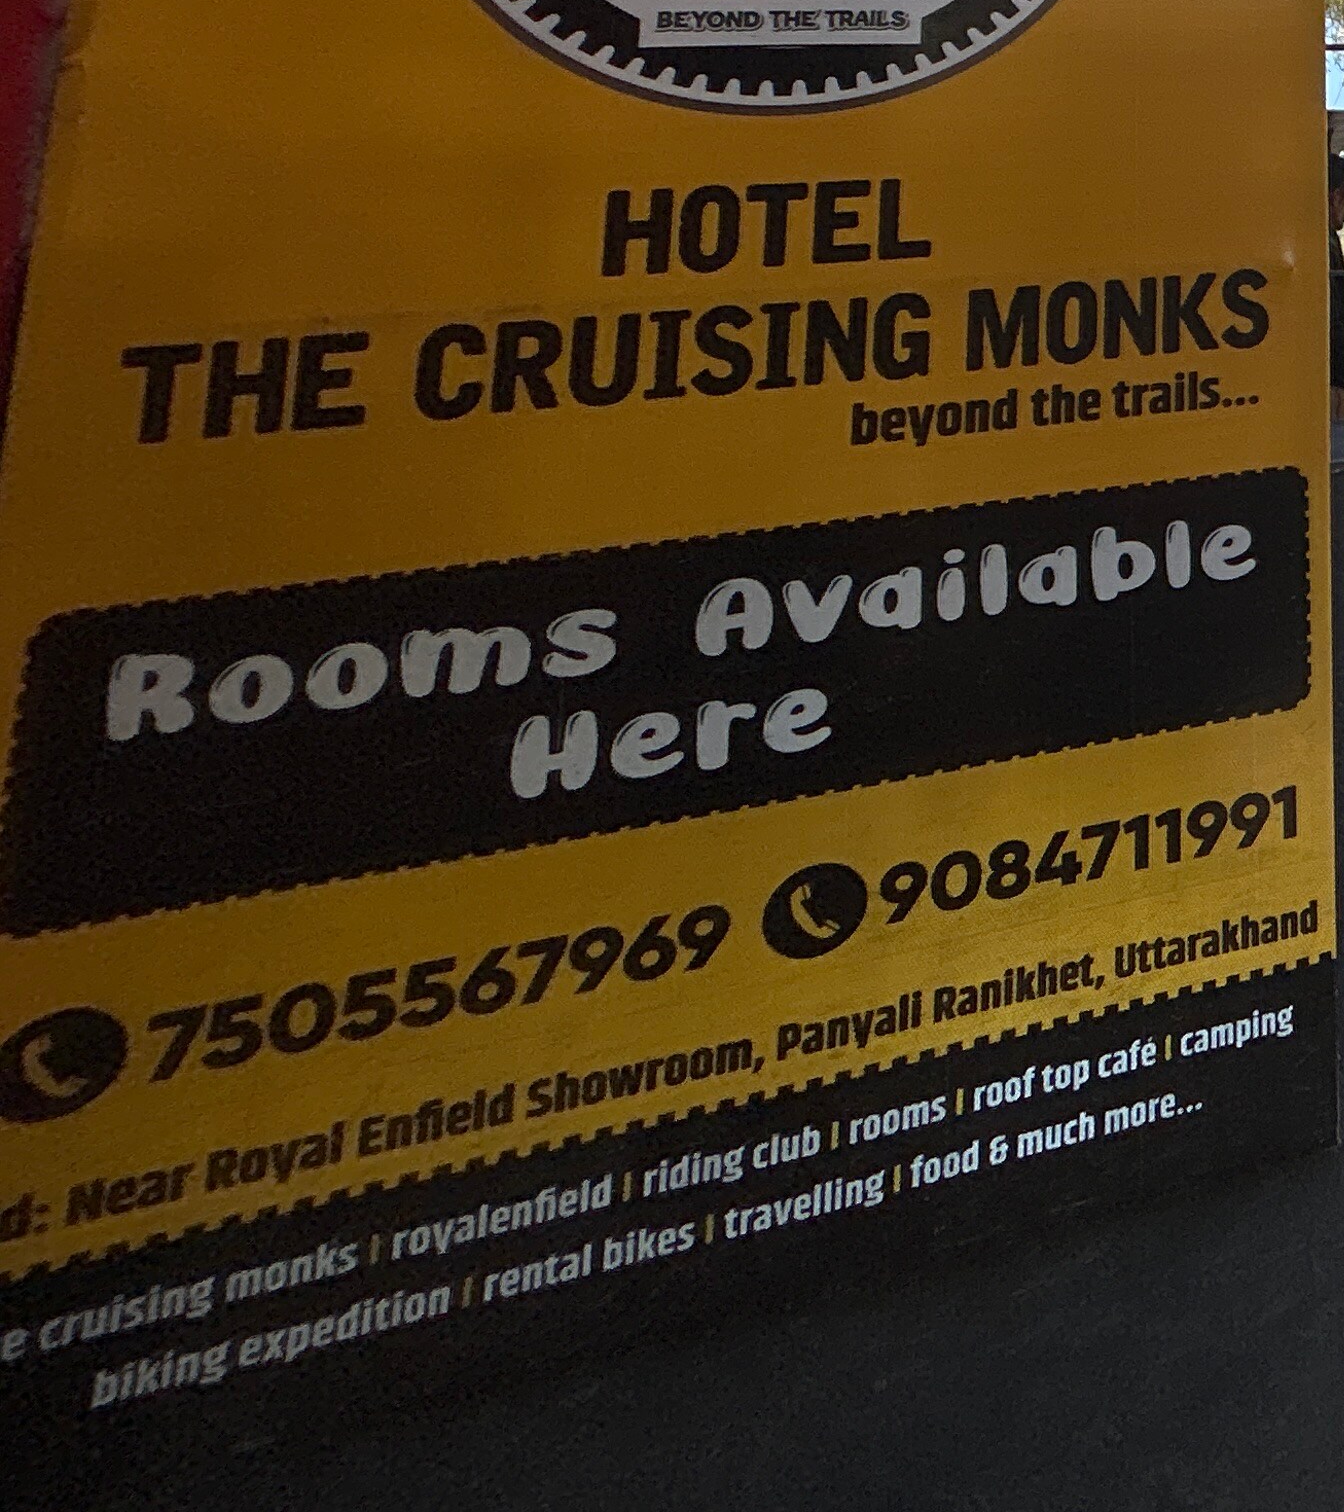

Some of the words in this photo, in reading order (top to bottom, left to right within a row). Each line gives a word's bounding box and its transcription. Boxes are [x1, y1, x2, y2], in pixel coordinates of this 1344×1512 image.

[655, 9, 764, 32] BEYOND
[768, 8, 821, 32] THE
[823, 9, 910, 31] TRAILS
[600, 176, 933, 278] HOTEL
[120, 329, 370, 445] THE
[412, 290, 932, 423] CRUISING
[963, 267, 1272, 374] MONKS
[849, 391, 1016, 447] beyond
[1028, 383, 1102, 429] the
[105, 605, 618, 744] Rooms
[693, 516, 1260, 659] Available
[508, 685, 833, 800] Here
[878, 784, 1299, 926] 9084711991
[64, 1160, 196, 1228] Near
[205, 1120, 345, 1193] Royal
[358, 1081, 516, 1157] Enfield
[525, 1035, 764, 1122] Showroom,
[776, 990, 923, 1063] Panyali
[932, 952, 1105, 1027] Ranikhet,
[1114, 899, 1319, 979] Uttarakhand
[147, 904, 731, 1084] 7505567969
[38, 1276, 213, 1352] cruising
[225, 1239, 359, 1305] monks
[390, 1172, 613, 1262] royalenfield
[642, 1142, 743, 1198] riding
[751, 1124, 822, 1172] club
[847, 1097, 947, 1145] rooms
[971, 1064, 1039, 1112] roof
[1041, 1057, 1090, 1094] top
[1097, 1035, 1158, 1081] café
[1178, 1003, 1295, 1058] camping
[89, 1345, 230, 1410] biking
[237, 1279, 452, 1372] expedition
[482, 1243, 593, 1303] rental
[601, 1220, 695, 1275] bikes
[724, 1169, 886, 1241] travelling
[909, 1138, 980, 1189] food
[989, 1134, 1009, 1167] &
[1015, 1111, 1096, 1158] much
